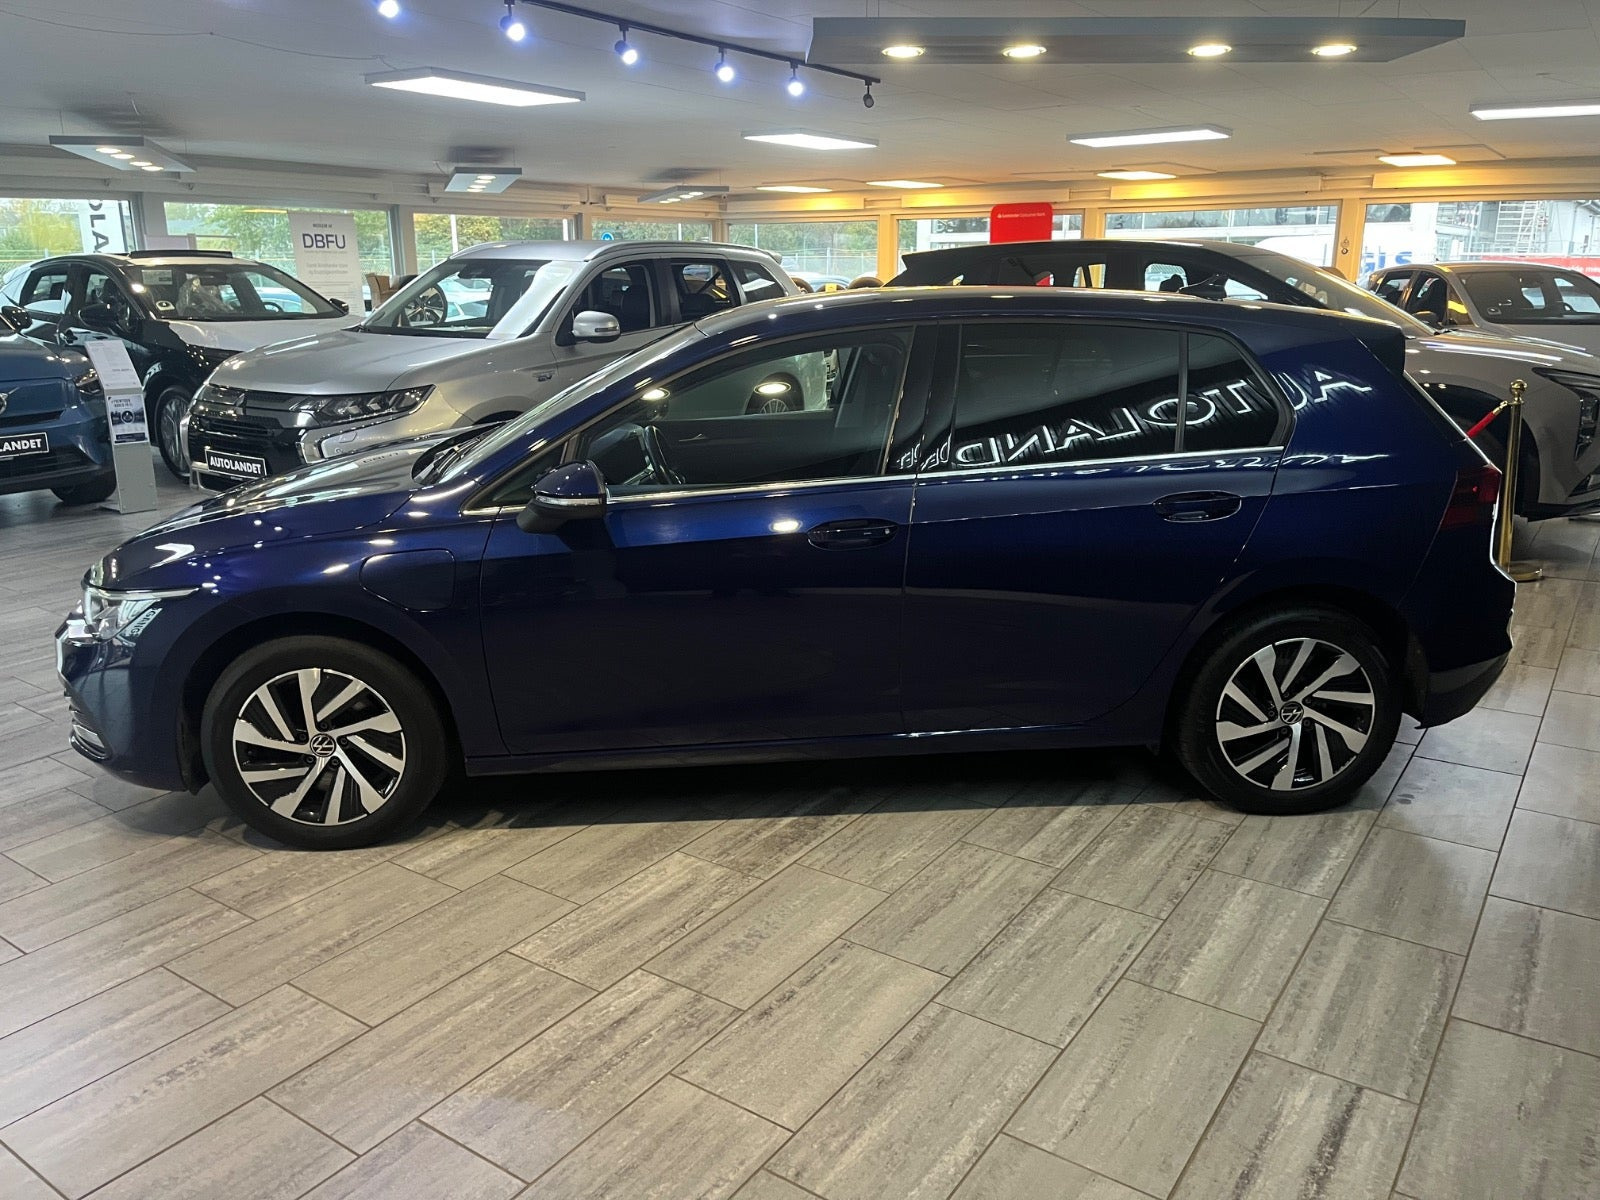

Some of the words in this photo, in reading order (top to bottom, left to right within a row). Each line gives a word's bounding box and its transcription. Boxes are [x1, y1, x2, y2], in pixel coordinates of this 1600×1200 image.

[89, 202, 109, 253] LA
[302, 233, 346, 249] DBFU
[0, 439, 42, 452] ANDET
[210, 456, 261, 474] AUTOLANDET
